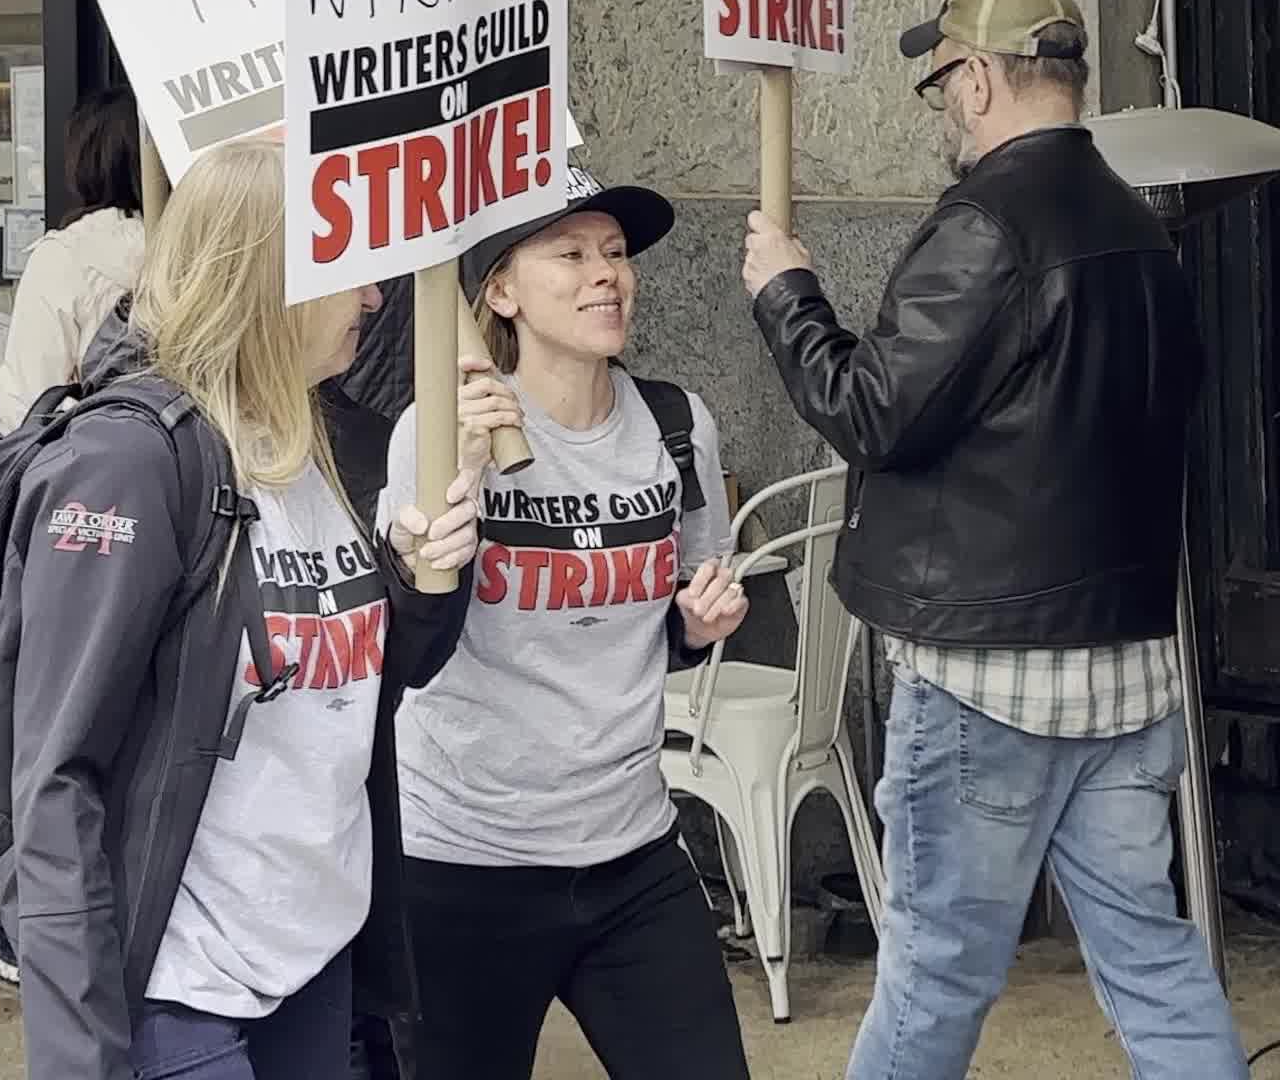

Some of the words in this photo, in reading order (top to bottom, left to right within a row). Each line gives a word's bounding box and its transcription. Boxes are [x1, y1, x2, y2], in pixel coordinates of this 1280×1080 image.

[164, 41, 285, 114] WRIT
[309, 23, 468, 104] WRITERS
[474, 0, 549, 64] GUILD
[440, 81, 468, 121] ON
[312, 88, 551, 264] STRIKE!
[483, 487, 600, 524] WRITERS
[573, 527, 603, 549] ON
